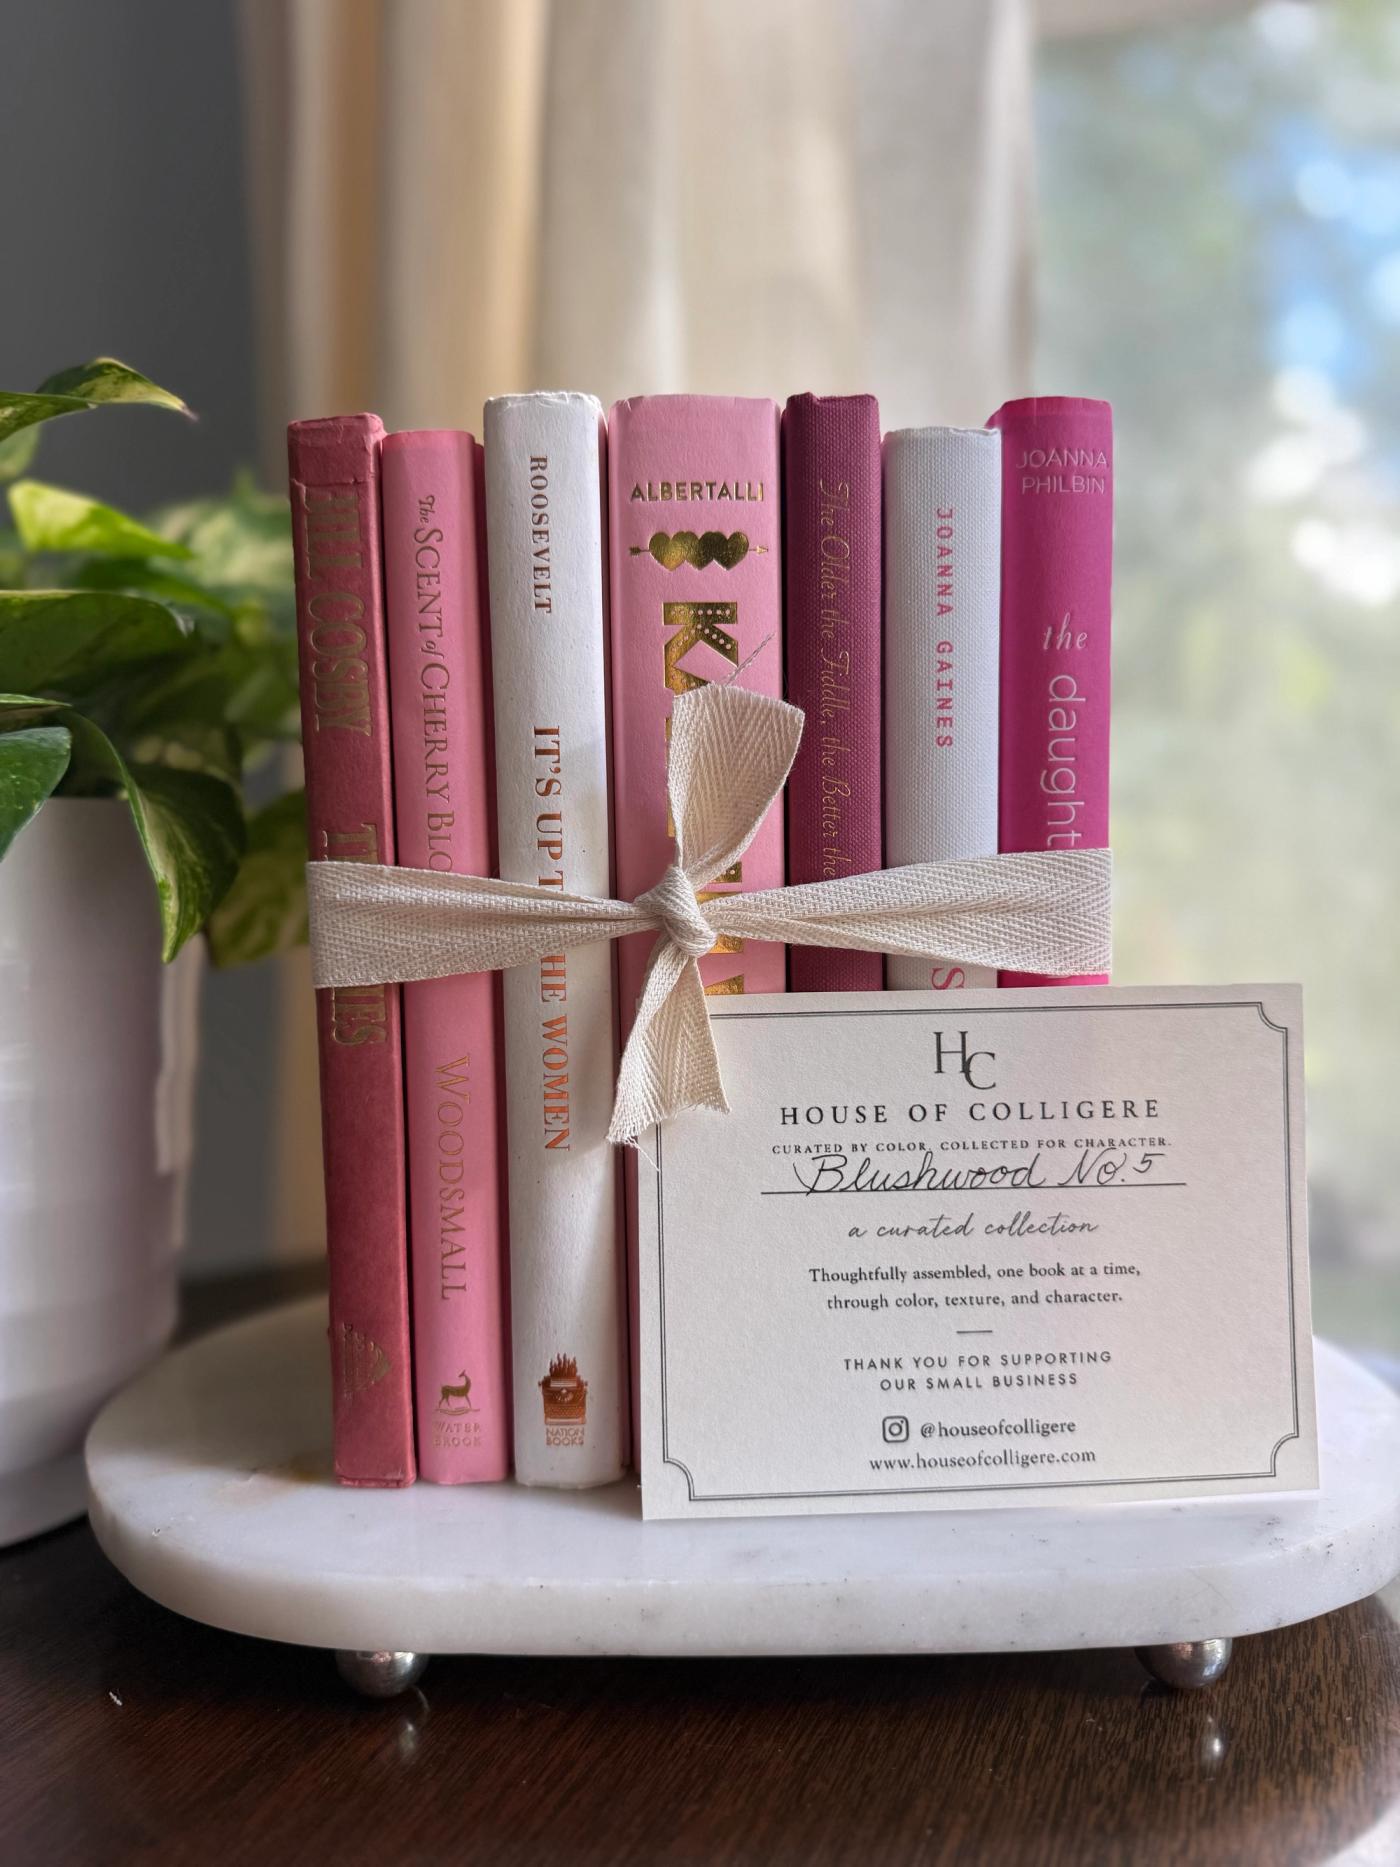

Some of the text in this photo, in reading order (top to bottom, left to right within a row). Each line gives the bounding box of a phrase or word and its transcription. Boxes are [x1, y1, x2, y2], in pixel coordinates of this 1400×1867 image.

[1016, 449, 1109, 469] JOANNA
[630, 481, 764, 501] ALBERTALLI
[1022, 475, 1105, 495] PHILBIN
[417, 495, 436, 524] The
[530, 455, 552, 614] ROOSEVELT
[414, 528, 444, 638] SCENT
[935, 508, 954, 748] JOANNA GAINES
[1042, 612, 1088, 650] the
[420, 640, 445, 660] of
[308, 592, 371, 736] COSBY
[820, 478, 852, 876] The Older the Fiddle, the Better the
[421, 663, 450, 805] CHERRY
[1040, 675, 1086, 847] daught
[533, 725, 570, 1152] IT'S UP T HE WOMEN
[332, 985, 388, 1046] IES
[780, 1099, 1159, 1125] HOUSE OF COLLIGERE
[772, 1143, 843, 1154] CURATED
[851, 1143, 868, 1152] BY
[940, 1139, 1029, 1150] COLLECTED
[1037, 1138, 1066, 1148] FOR
[1074, 1136, 1172, 1148] CHARACTER.
[434, 1055, 471, 1300] WOODSMALL
[793, 1148, 1165, 1197] Blushwood No. 5
[848, 1211, 1098, 1239] a curated collection
[809, 1262, 1141, 1285] Thoughtfully assembled, one book at a time,
[827, 1289, 1122, 1311] through color, texture, and character.
[843, 1351, 1111, 1370] THANK YOU FOR SUPPORTING
[880, 1373, 1077, 1391] OUR SMALL BUSINESS
[433, 1421, 481, 1433] WATER
[545, 1427, 585, 1438] NATION
[920, 1418, 1076, 1438] @houseofcolligere
[434, 1436, 482, 1447] BROOK
[546, 1437, 585, 1446] BOOKS
[869, 1449, 1096, 1469] www.houseofcolligere.com
